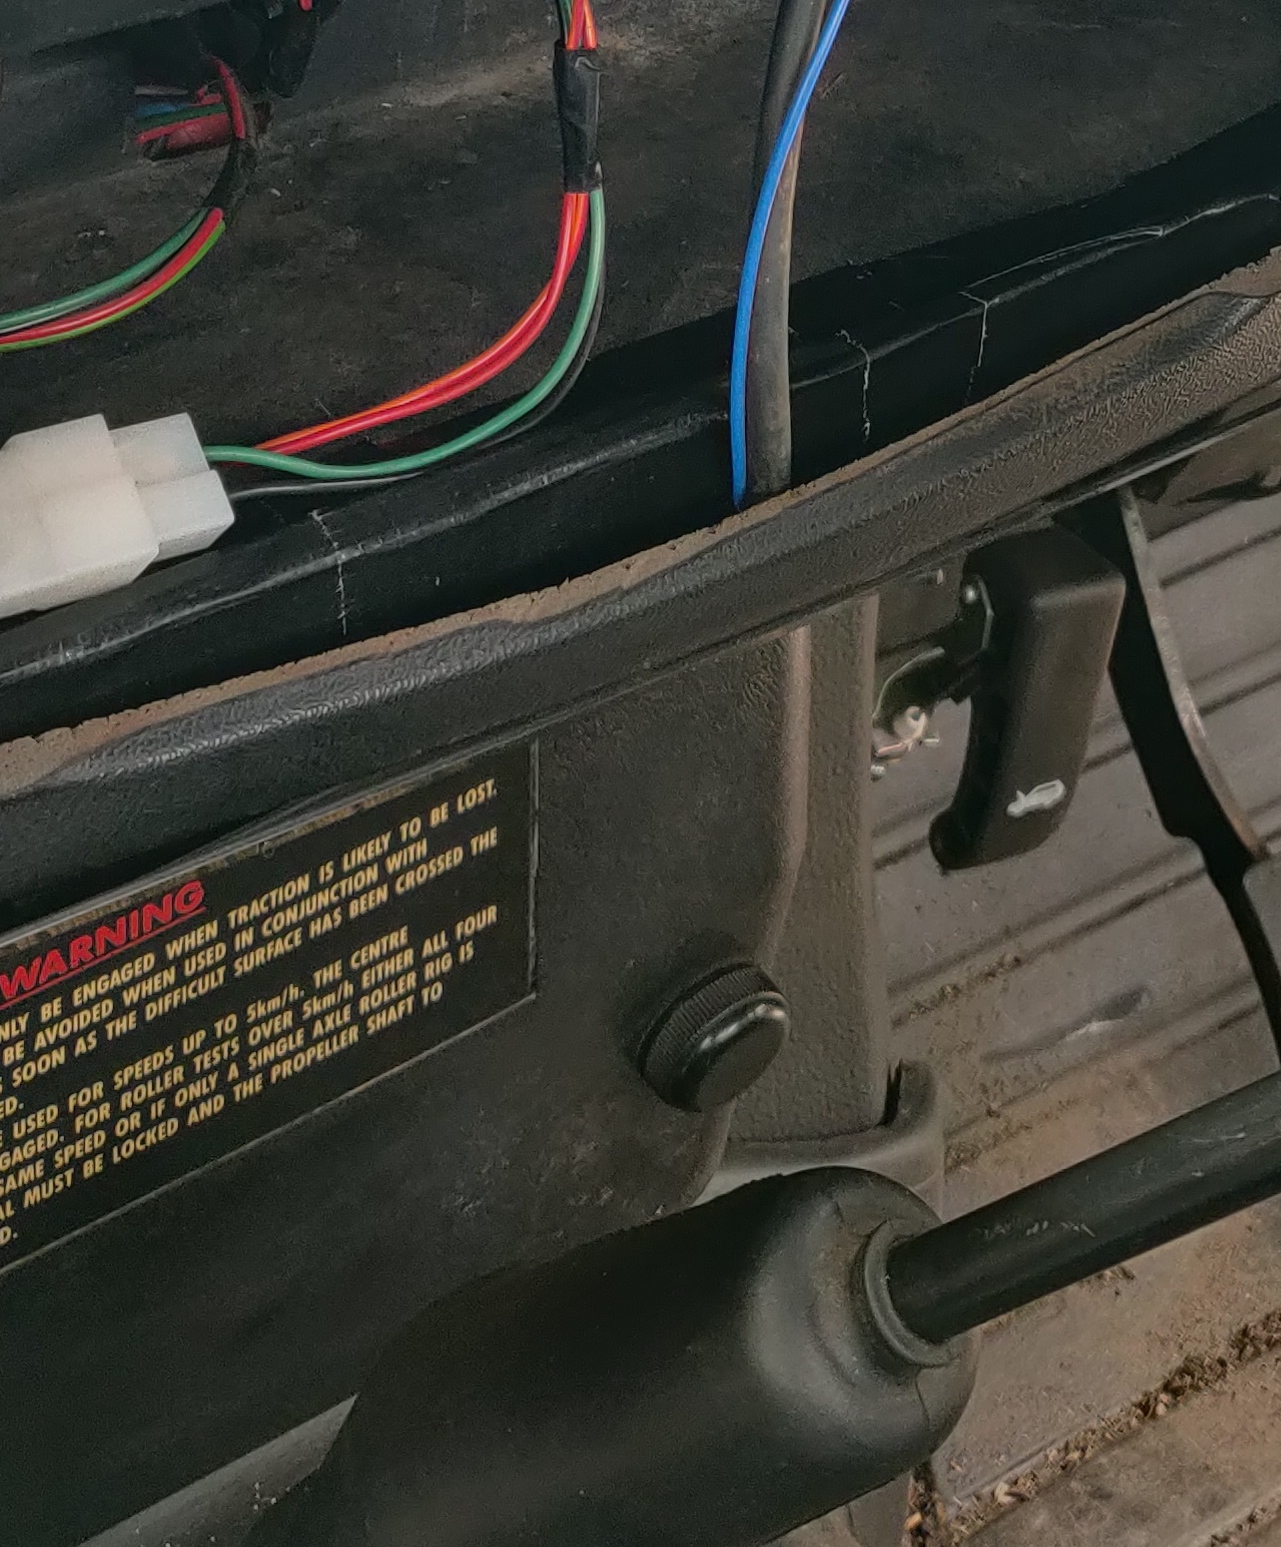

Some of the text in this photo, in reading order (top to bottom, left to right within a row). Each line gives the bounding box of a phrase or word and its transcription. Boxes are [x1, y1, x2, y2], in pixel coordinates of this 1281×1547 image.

[3, 1039, 25, 1066] BE
[34, 998, 114, 1050] AVOIDED
[122, 965, 177, 1006] WHEN
[184, 941, 227, 976] USED
[234, 926, 255, 951] IN
[262, 862, 379, 936] CONJUNCTION
[385, 837, 428, 873] WITH
[12, 1045, 66, 1087] SOON
[75, 1029, 98, 1056] AS
[105, 1009, 138, 1040] THE
[145, 965, 227, 1021] DIFFICULT
[234, 926, 303, 975] SURFACE
[309, 906, 343, 938] HAS
[349, 882, 389, 919] BEEN
[395, 845, 464, 894] CROSSED
[470, 826, 498, 855] THE
[40, 996, 63, 1023] BE
[73, 952, 156, 1006] ENGAGED
[165, 919, 219, 960] WHEN
[228, 873, 311, 928] TRACTION
[319, 860, 335, 883] IS
[342, 831, 392, 872] LIKELY
[400, 816, 422, 841] TO
[430, 801, 449, 827] BE
[457, 778, 497, 813] LOST.
[13, 1104, 59, 1139] USED
[68, 1080, 104, 1113] FOR
[114, 1044, 175, 1090] SPEEDS
[183, 1029, 207, 1054] UP
[214, 1013, 238, 1038] TO
[247, 983, 305, 1023] 5km/h.
[313, 958, 343, 988] THE
[350, 925, 408, 969] CENTRE
[24, 1167, 75, 1208] MUST
[83, 1153, 104, 1179] BE
[113, 1117, 179, 1163] LOCKED
[188, 1093, 225, 1125] AND
[233, 1072, 264, 1102] THE
[271, 1024, 360, 1082] PROPELLER
[367, 994, 415, 1034] SHAFT
[421, 980, 443, 1005] TO
[55, 1129, 107, 1168] SPEED
[115, 1111, 142, 1137] OR
[151, 1097, 166, 1120] IF
[175, 1070, 219, 1107] ONLY
[227, 1061, 240, 1082] A
[248, 1027, 305, 1069] SINGLE
[313, 1003, 352, 1038] AXLE
[359, 970, 418, 1014] ROLLER
[424, 951, 453, 979] RIG
[459, 940, 475, 962] IS
[75, 1101, 111, 1134] FOR
[120, 1065, 185, 1111] ROLLER
[193, 1035, 240, 1072] TESTS
[248, 1009, 294, 1046] OVER
[303, 979, 355, 1018] 5km/h
[361, 947, 415, 989] EITHER
[422, 929, 449, 958] ALL
[455, 904, 498, 940] FOUR
